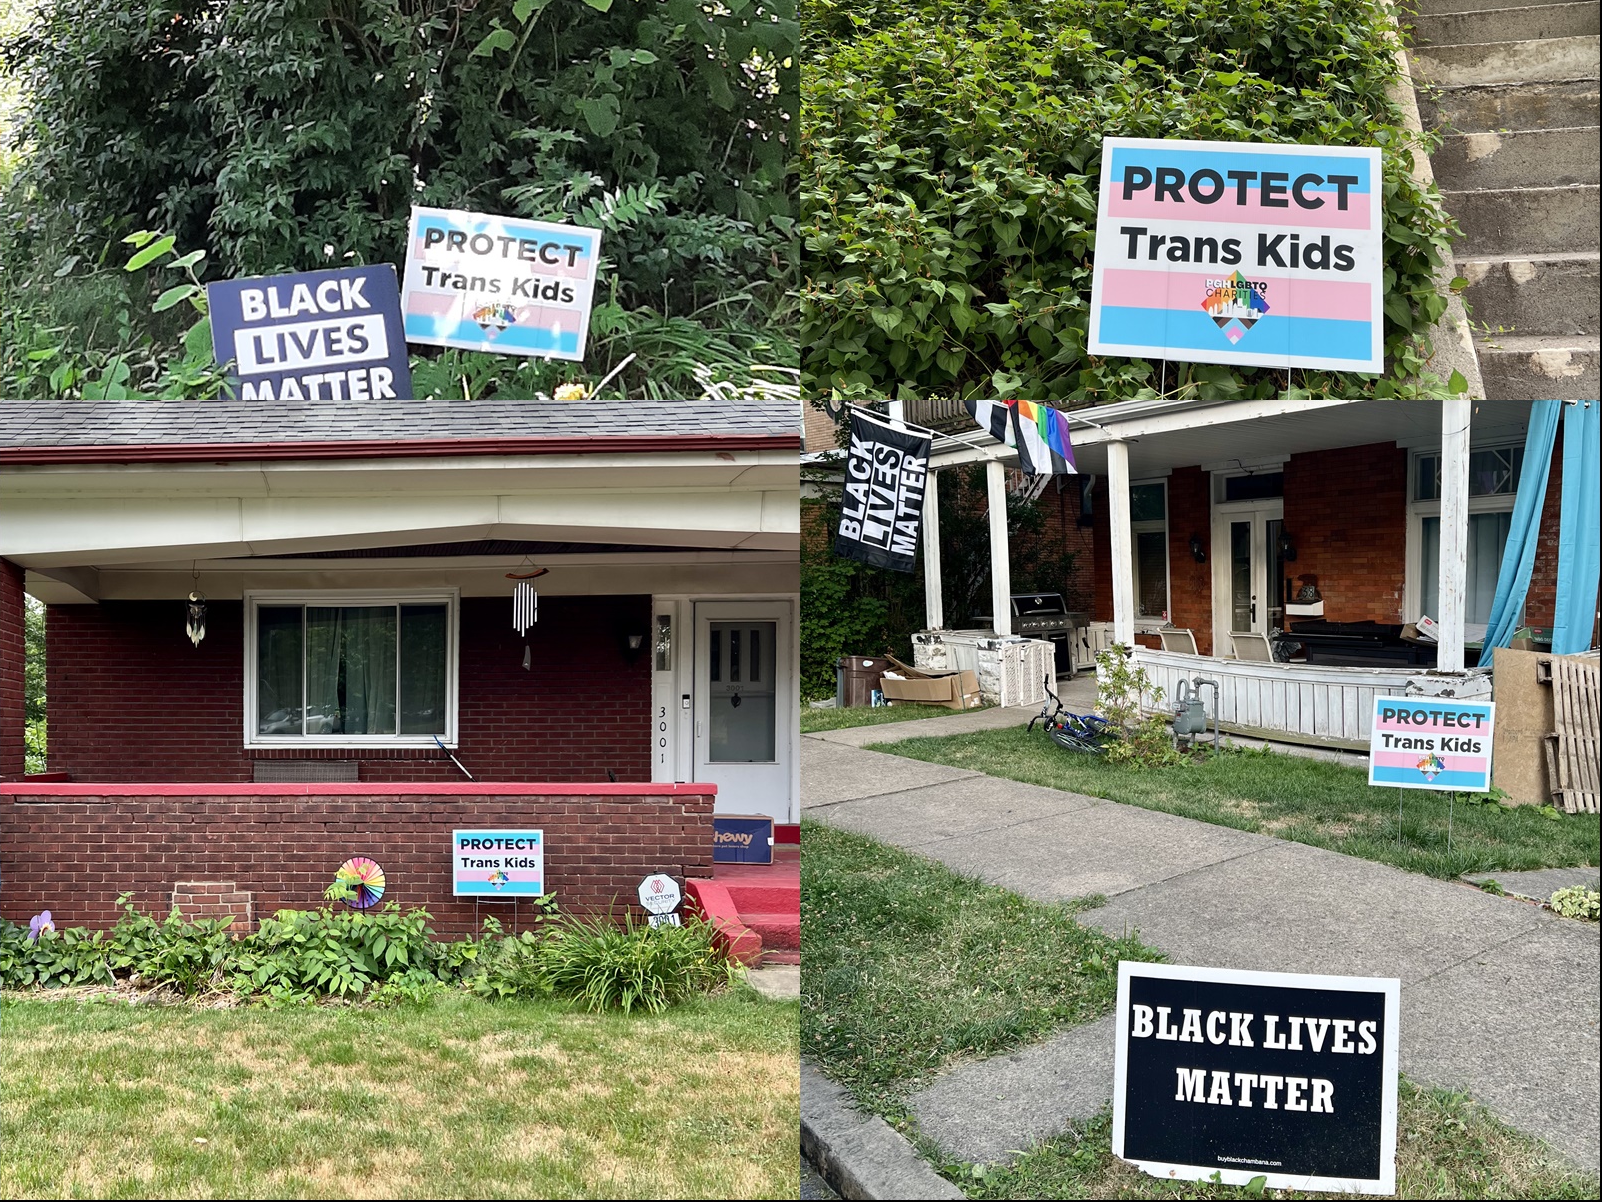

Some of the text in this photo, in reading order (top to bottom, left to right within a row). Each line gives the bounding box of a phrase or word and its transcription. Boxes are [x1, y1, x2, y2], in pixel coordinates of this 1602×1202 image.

[1122, 166, 1359, 211] PROTECT
[424, 226, 583, 268] PROTECT
[1120, 226, 1355, 271] Trans Kids
[240, 276, 370, 322] BLACK
[421, 265, 575, 304] Trans Kids
[1206, 288, 1266, 299] CHARITIES
[253, 323, 369, 366] LIVES
[241, 366, 397, 400] MATTER
[838, 432, 875, 541] BLACK
[862, 446, 901, 549] LIVES
[891, 454, 927, 557] MATTER
[1382, 707, 1485, 729] PROTECT
[1381, 734, 1482, 753] Trans Kids
[460, 838, 536, 850] PROTECT
[713, 830, 753, 845] hewy
[461, 857, 535, 868] Trans Kids
[645, 893, 675, 902] VECTOR
[1131, 1004, 1377, 1055] BLACK LIVES
[1175, 1067, 1334, 1114] MATTER
[1217, 1154, 1282, 1168] buyblackchambana.com
